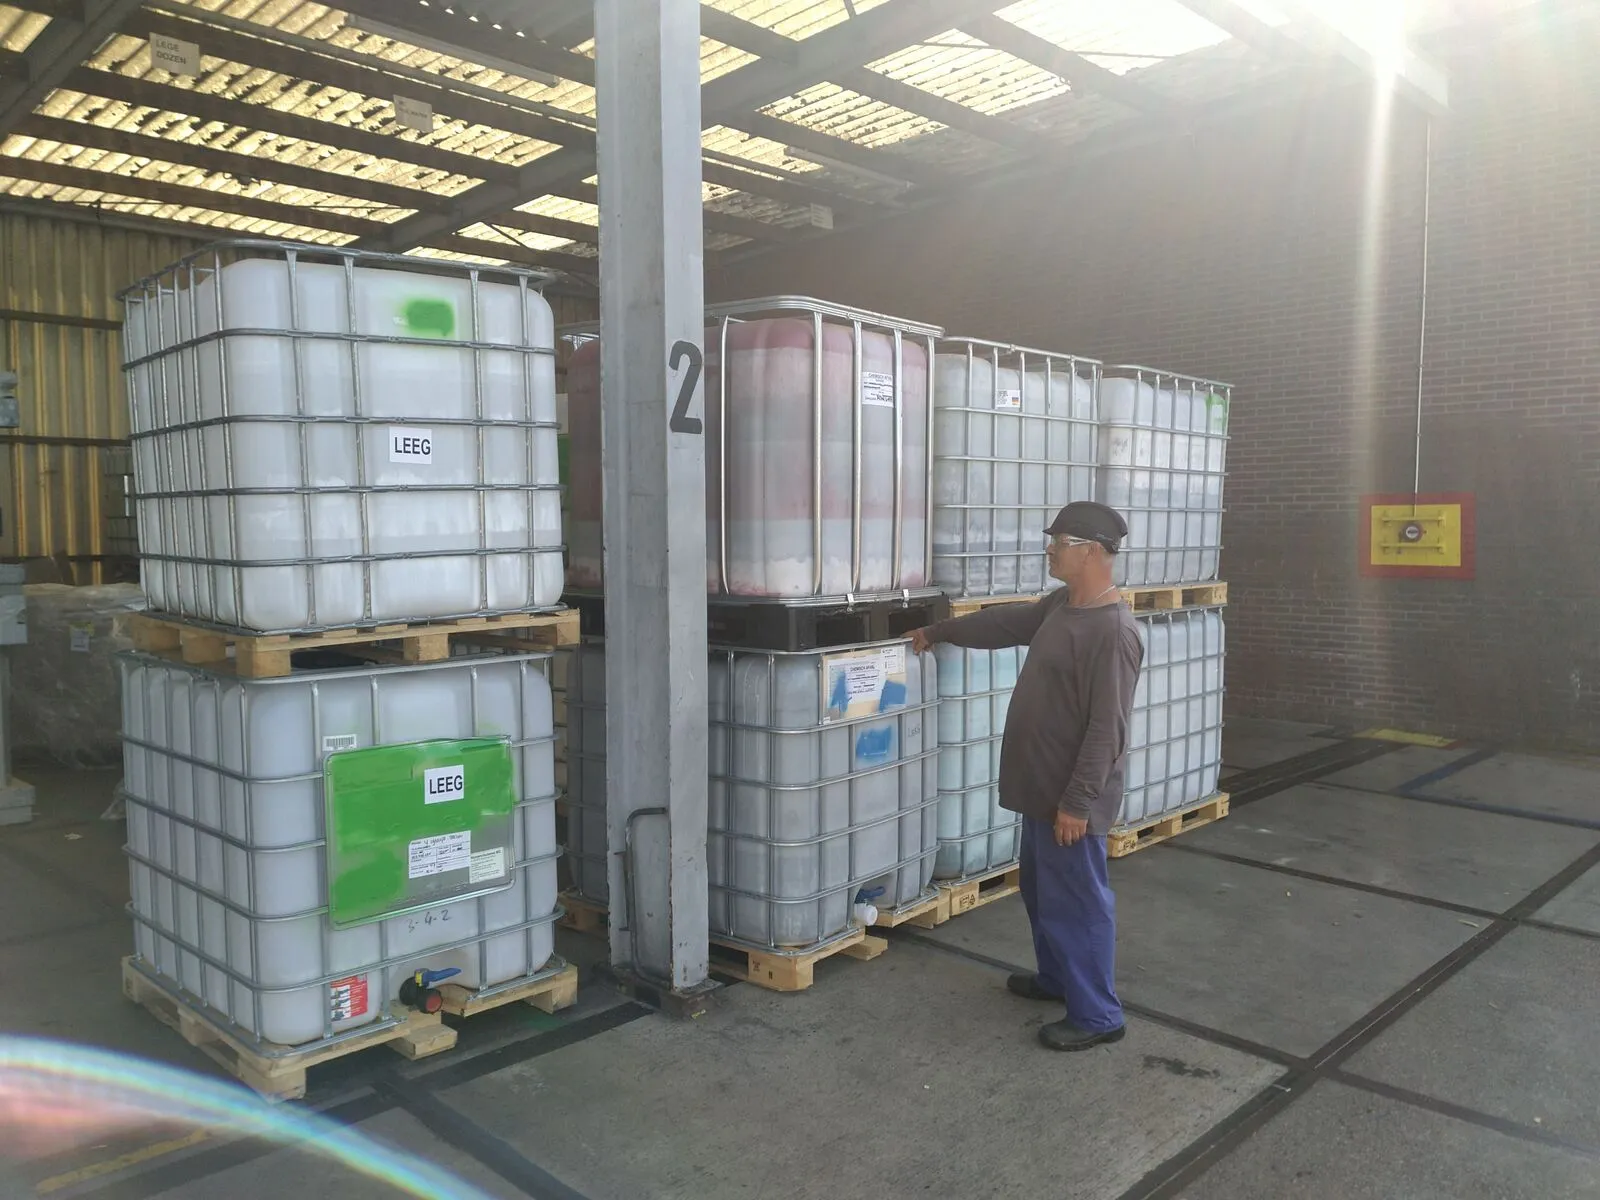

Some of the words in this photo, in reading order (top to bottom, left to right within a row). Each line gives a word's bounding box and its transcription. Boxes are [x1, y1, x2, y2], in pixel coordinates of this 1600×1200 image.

[156, 40, 180, 52] LEGE
[156, 51, 186, 64] DOZEN
[669, 341, 702, 434] 2
[394, 436, 431, 455] LEEG
[429, 775, 463, 794] LEEG
